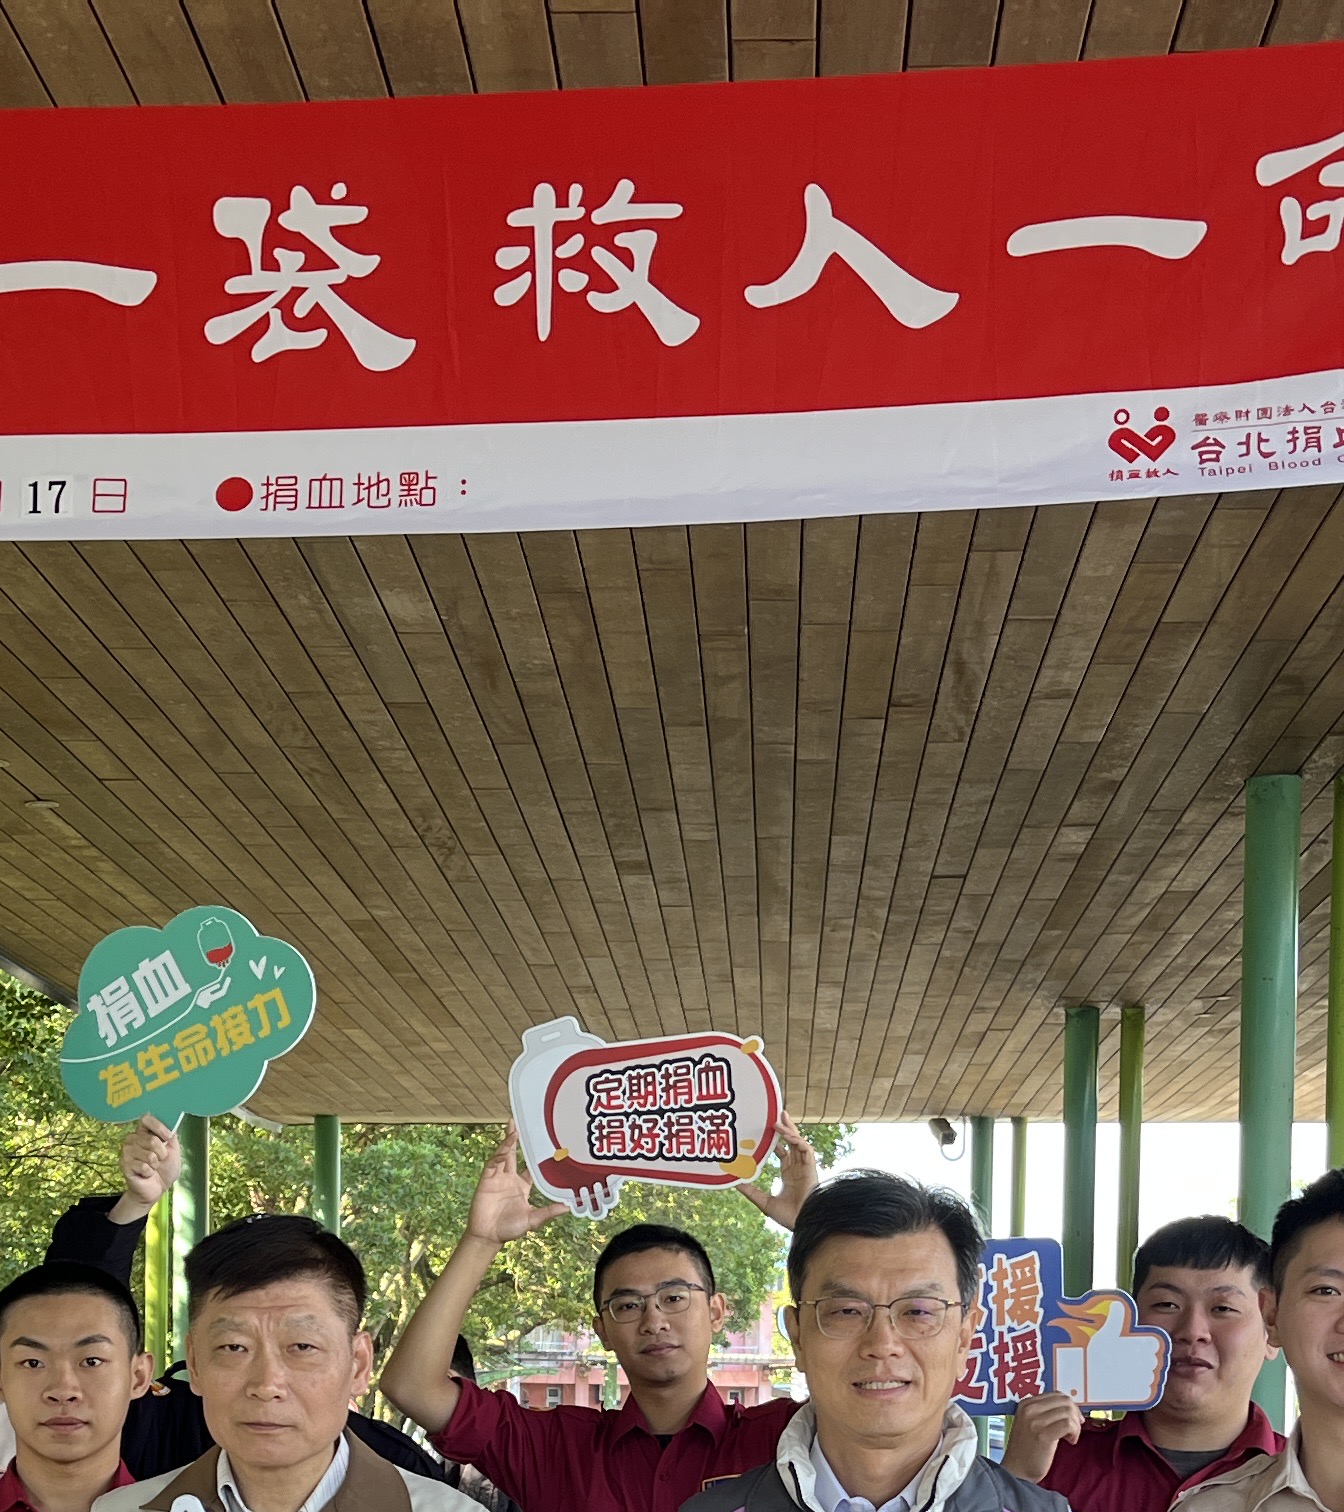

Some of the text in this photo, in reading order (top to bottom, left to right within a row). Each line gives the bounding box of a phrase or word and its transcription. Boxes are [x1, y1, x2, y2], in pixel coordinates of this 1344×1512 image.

[1198, 462, 1254, 479] Taipei
[1268, 457, 1322, 471] Blood
[29, 480, 69, 515] 17
[92, 478, 129, 514] 日
[87, 950, 191, 1047] 捐血
[98, 987, 292, 1108] 為生命接力
[591, 1060, 729, 1113] 定期捐血
[593, 1111, 733, 1159] 捐好捐滿
[970, 1253, 1041, 1327] 援
